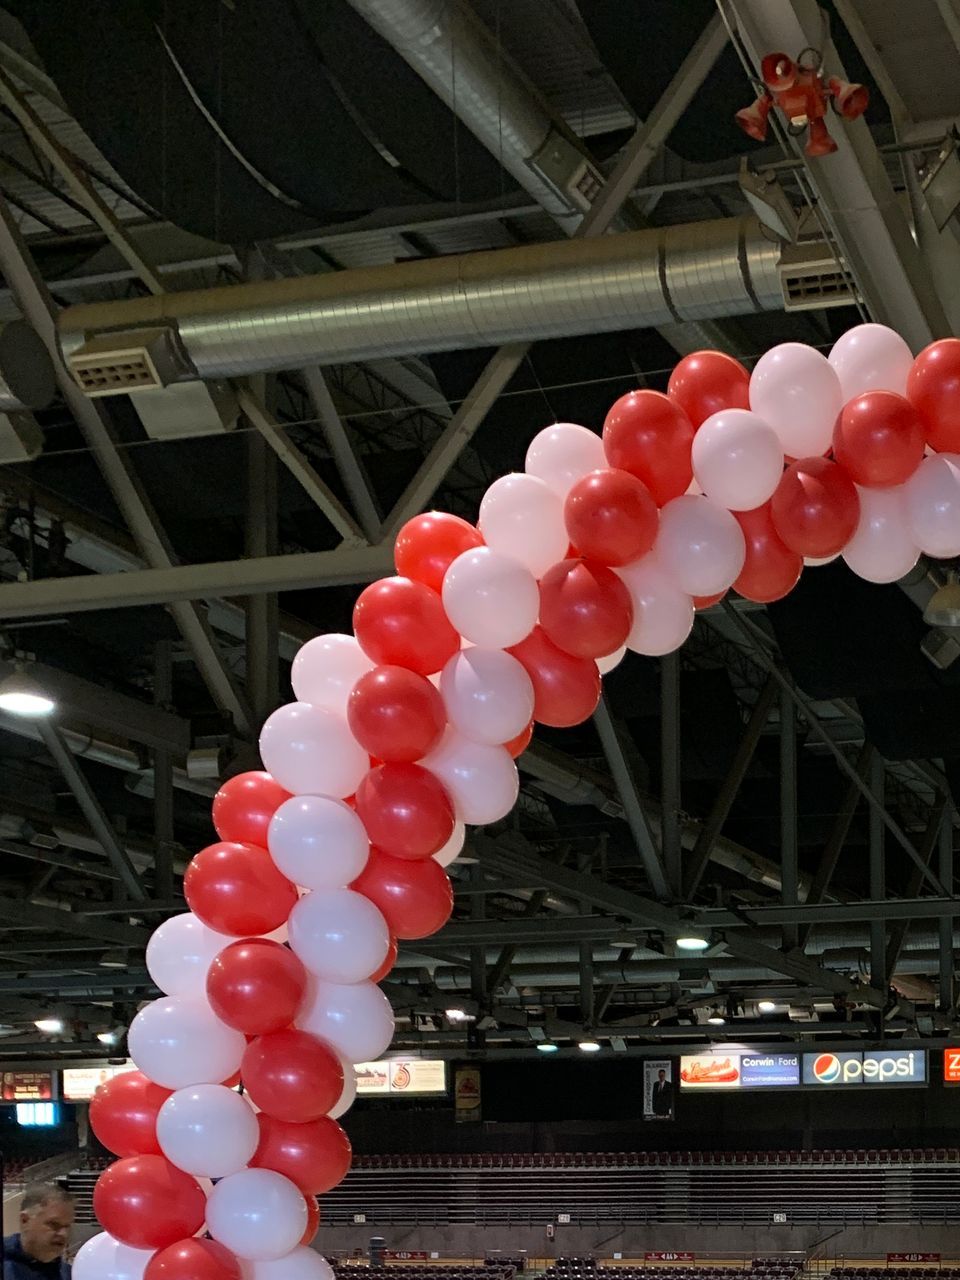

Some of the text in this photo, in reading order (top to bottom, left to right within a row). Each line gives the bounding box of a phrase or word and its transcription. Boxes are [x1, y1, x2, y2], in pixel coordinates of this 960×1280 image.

[743, 1057, 798, 1067] Corwin Ford
[843, 1052, 915, 1082] pepsi
